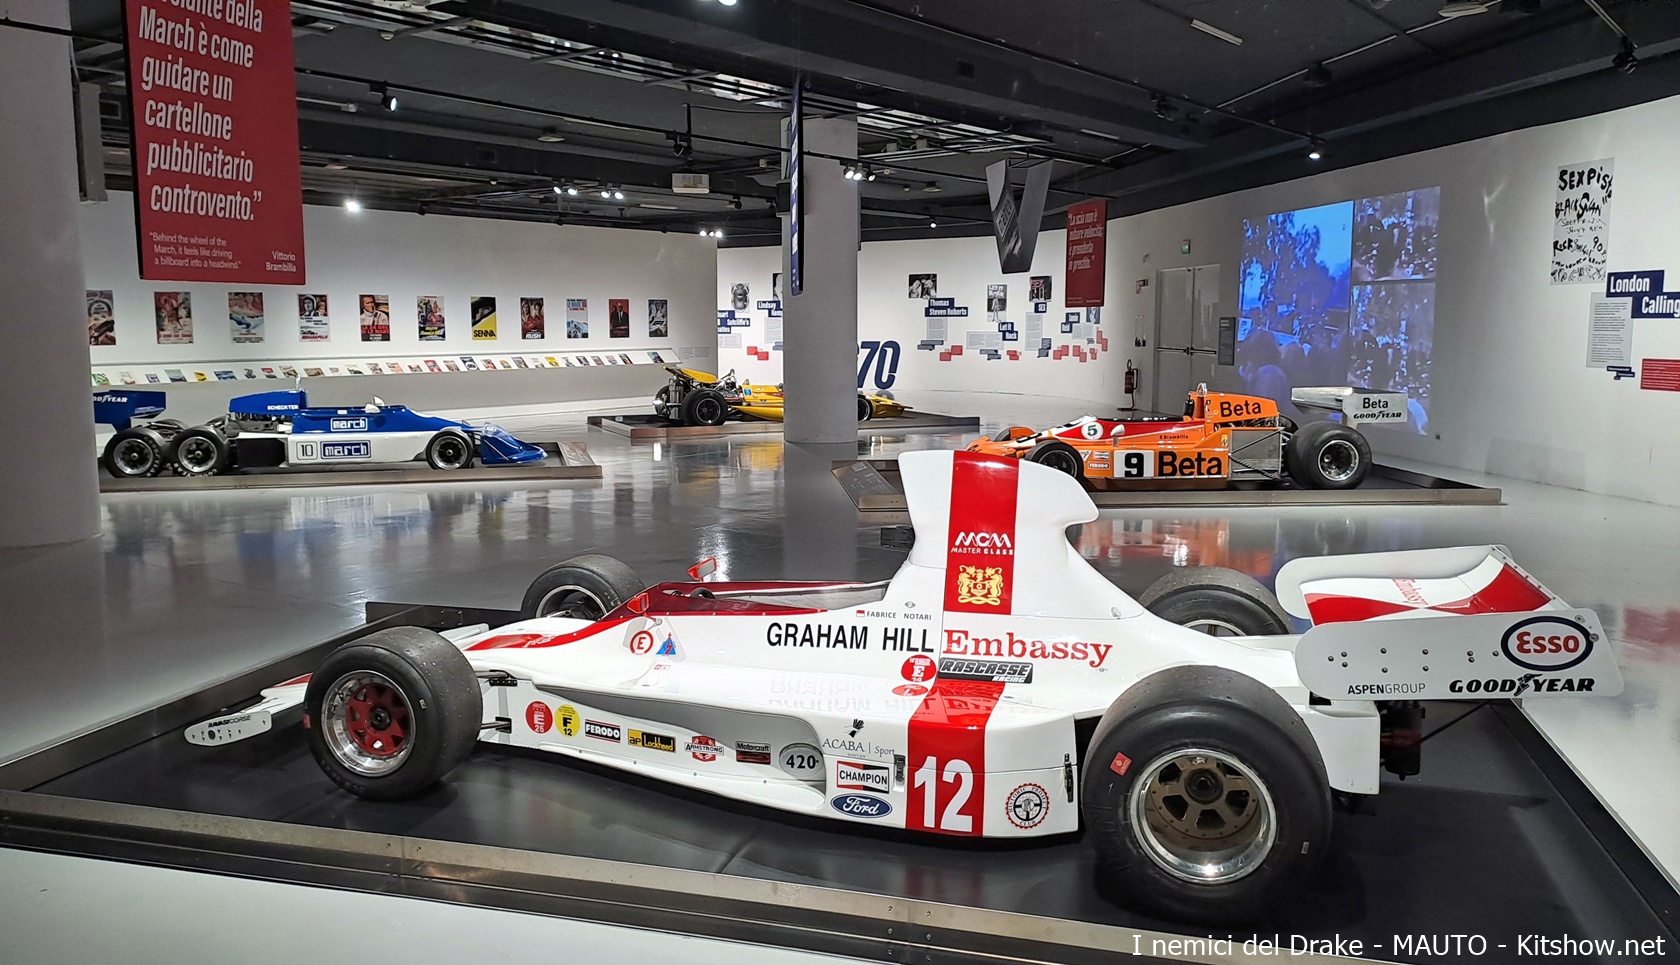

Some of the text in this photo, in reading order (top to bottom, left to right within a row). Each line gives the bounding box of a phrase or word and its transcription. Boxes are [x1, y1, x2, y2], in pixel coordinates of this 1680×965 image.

[139, 6, 253, 67] March è come
[141, 54, 233, 101] guidare un
[145, 100, 232, 140] cartellone
[147, 138, 253, 183] pubblicitario
[178, 235, 188, 244] the
[217, 236, 227, 247] the
[211, 248, 232, 260] driving
[272, 251, 296, 261] Vittorio
[161, 256, 190, 267] billboard
[266, 262, 296, 272] Brambilla
[1610, 275, 1650, 293] London
[758, 302, 776, 310] Lindsay
[1642, 295, 1680, 318] Calling
[473, 329, 496, 338] SENNA
[1220, 400, 1262, 417] Beta
[1363, 397, 1389, 409] Beta
[333, 418, 365, 429] march
[1087, 425, 1098, 436] 5
[301, 443, 367, 457] 10 march
[1124, 452, 1145, 477] 9
[1158, 451, 1222, 476] Beta
[955, 531, 1012, 548] MCM
[866, 610, 896, 619] FABRICE
[637, 636, 647, 650] E
[766, 622, 934, 653] GRAHAM HILL
[943, 629, 1113, 668] Embassy
[912, 666, 925, 677] E
[940, 659, 1031, 677] RASCASSE
[991, 675, 1027, 683] RACING
[1348, 682, 1426, 695] ASPENGROUP
[534, 714, 545, 725] E
[562, 716, 573, 727] F
[534, 725, 545, 733] 25
[563, 728, 573, 736] 12
[585, 723, 620, 738] FERODO
[643, 734, 674, 751] Lockheed
[685, 743, 723, 753] ARMSTRONG
[737, 743, 769, 752] Motorcraft
[822, 738, 895, 757] ACABA Sport
[786, 754, 816, 769] 420
[839, 770, 888, 785] CHAMPION
[914, 755, 974, 833] 12
[842, 796, 880, 815] Ford
